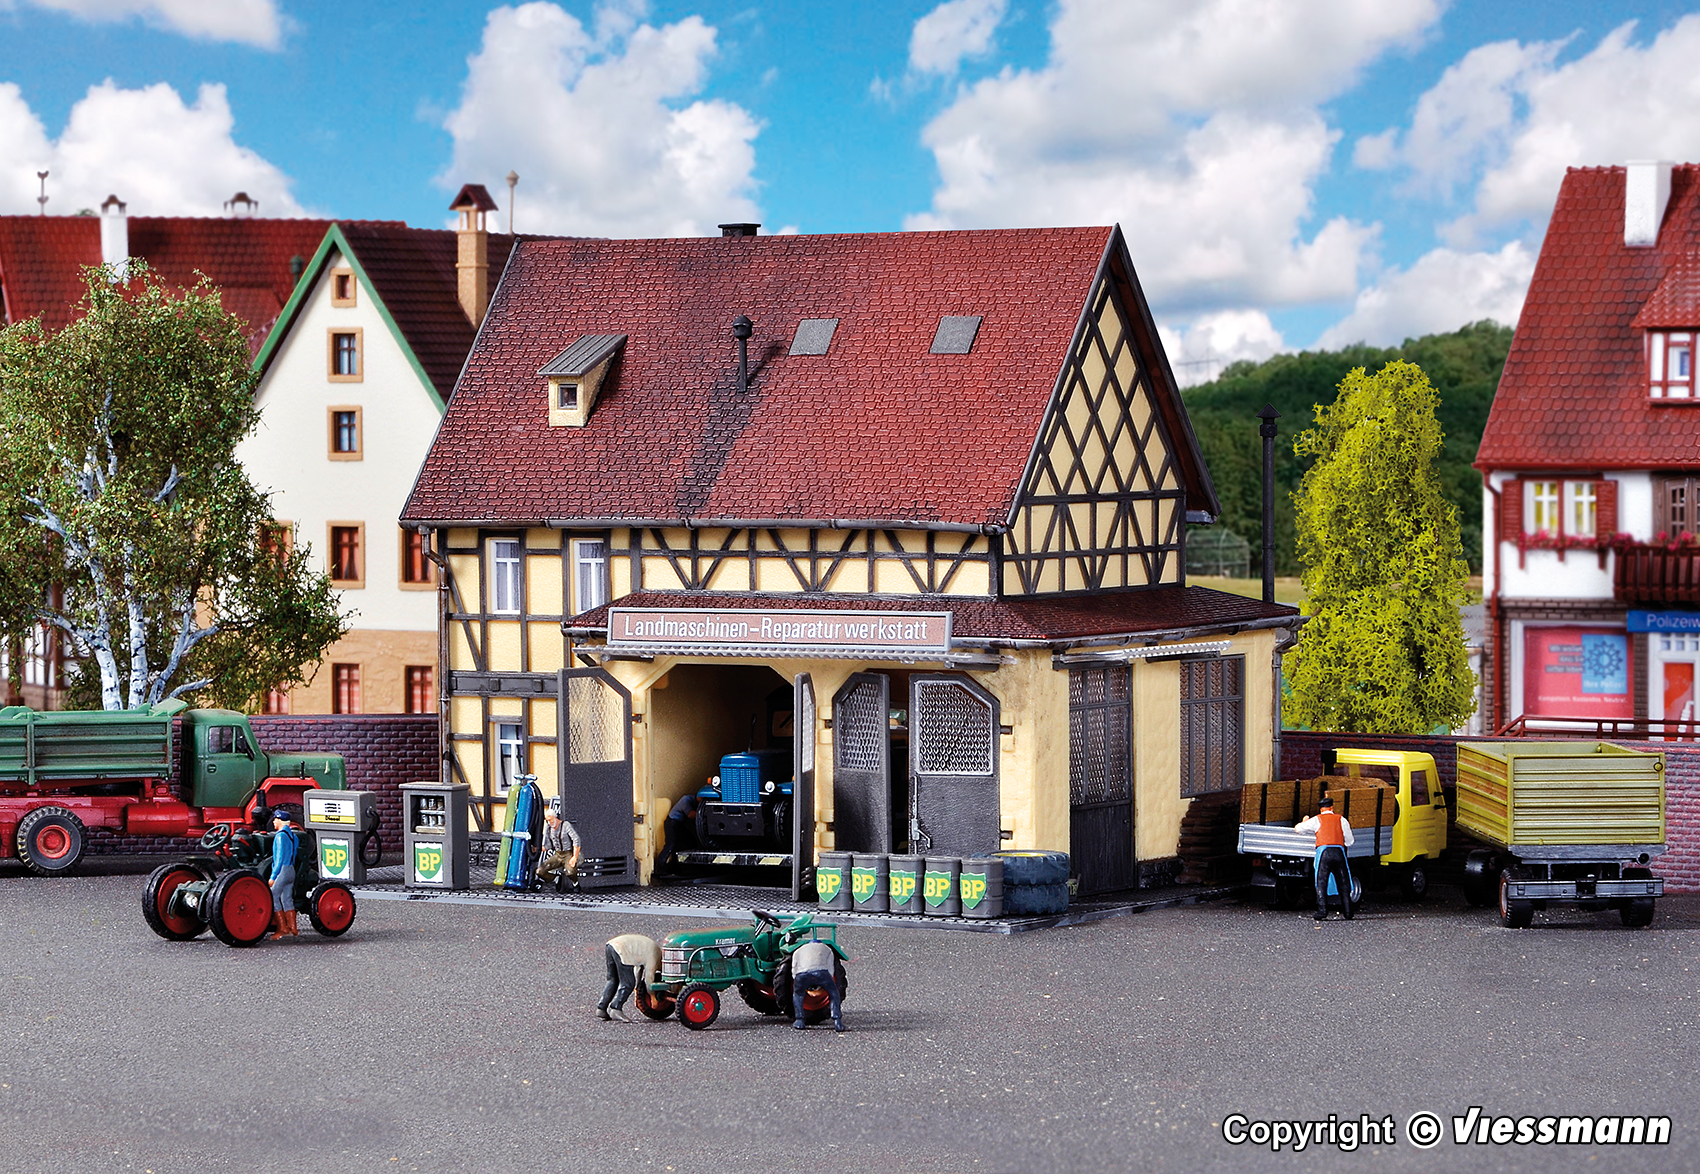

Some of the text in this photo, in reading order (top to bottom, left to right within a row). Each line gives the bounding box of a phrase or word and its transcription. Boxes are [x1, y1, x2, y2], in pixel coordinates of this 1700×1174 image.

[325, 848, 347, 868] BP
[418, 852, 441, 872] BP
[818, 873, 841, 893] BP
[853, 873, 876, 893] BP
[890, 877, 916, 897] BP
[925, 877, 951, 897] BP
[961, 879, 986, 899] BP
